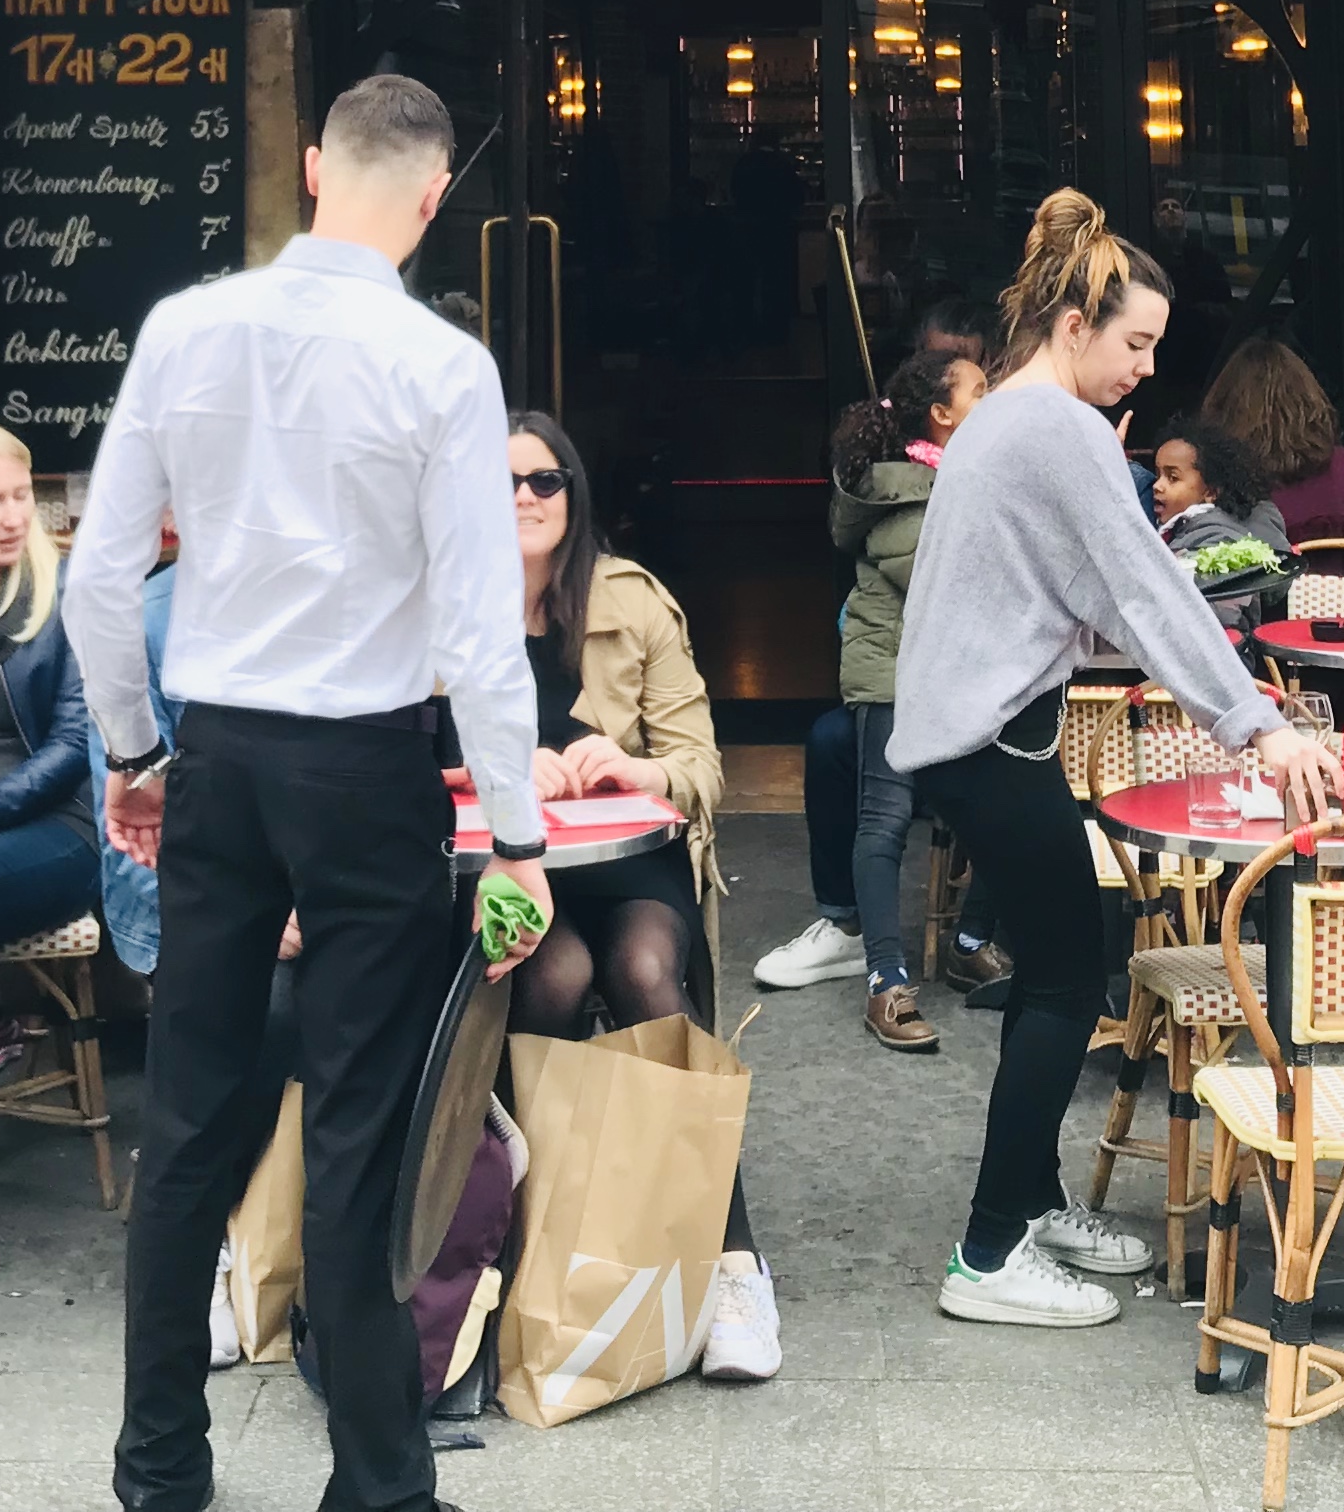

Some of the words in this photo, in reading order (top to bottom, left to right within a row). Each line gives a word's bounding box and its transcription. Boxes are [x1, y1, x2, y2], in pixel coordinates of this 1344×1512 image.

[88, 114, 169, 149] Spritz
[2, 164, 160, 207] Kronenbourg
[3, 214, 98, 268] Chouffe
[2, 270, 54, 304] Vin
[3, 327, 128, 365] Cocktails
[2, 390, 113, 440] Sangri
